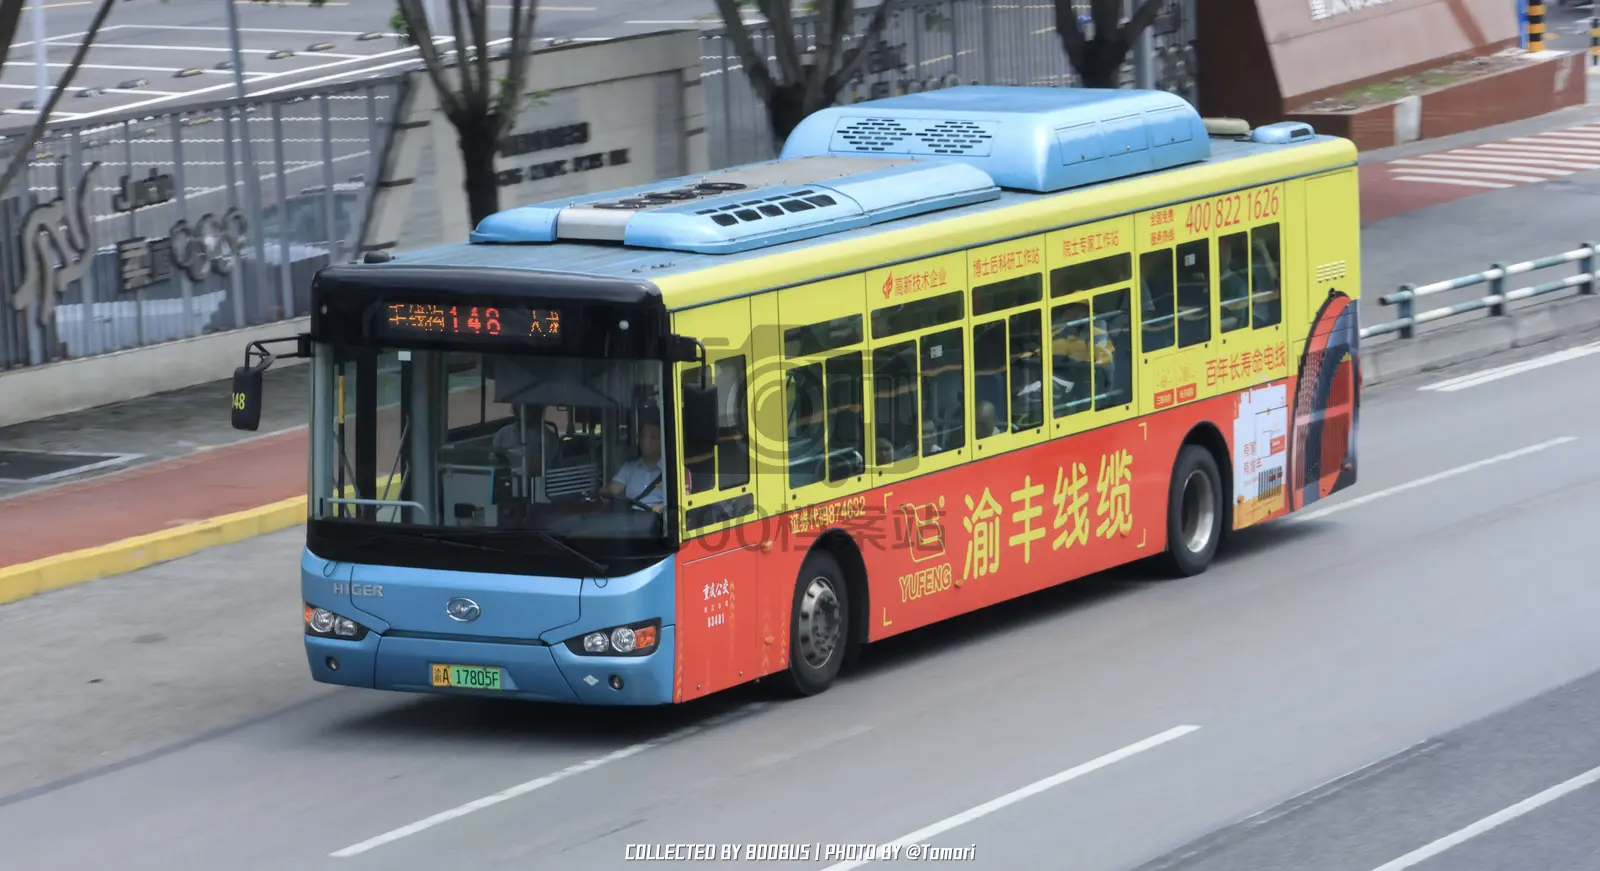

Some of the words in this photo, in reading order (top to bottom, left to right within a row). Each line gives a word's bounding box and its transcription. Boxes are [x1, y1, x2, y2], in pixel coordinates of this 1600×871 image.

[1186, 201, 1211, 234] 400
[1215, 195, 1241, 228] 822
[1247, 186, 1279, 222] 1626
[1063, 230, 1119, 258] 院士专家工作站
[973, 247, 1040, 278] 博士后科研工作站
[895, 267, 947, 296] 高新技术企业
[449, 305, 501, 335] 148
[1205, 341, 1287, 387] 百年长寿命电线
[963, 448, 1133, 581] 渝丰线缆
[334, 583, 384, 598] HIGER
[899, 562, 953, 603] YUFENG
